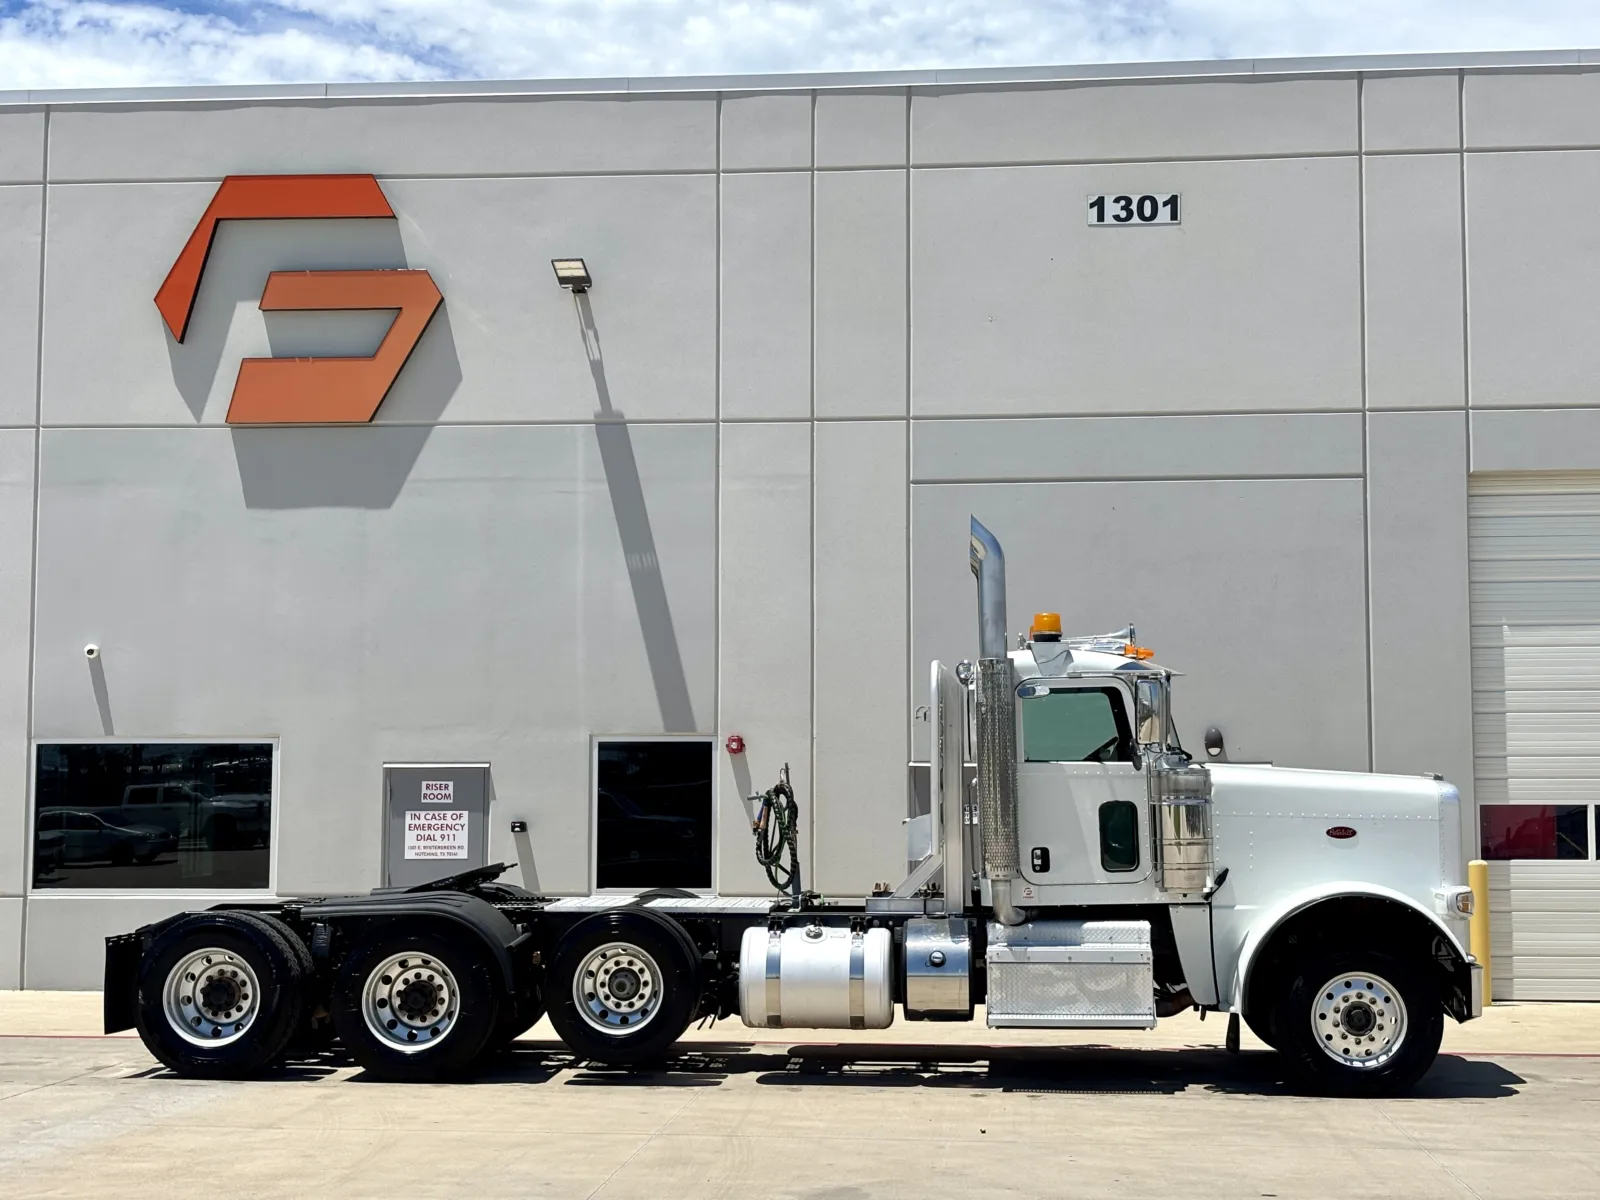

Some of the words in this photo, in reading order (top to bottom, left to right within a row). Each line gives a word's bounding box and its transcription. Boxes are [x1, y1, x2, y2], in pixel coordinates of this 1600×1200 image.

[1089, 194, 1178, 222] 1301
[425, 783, 450, 791] RISER
[422, 792, 452, 801] ROOM
[410, 813, 421, 821] IN
[424, 813, 447, 821] CASE
[450, 813, 464, 821] OF
[408, 823, 466, 831] EMERGENCY
